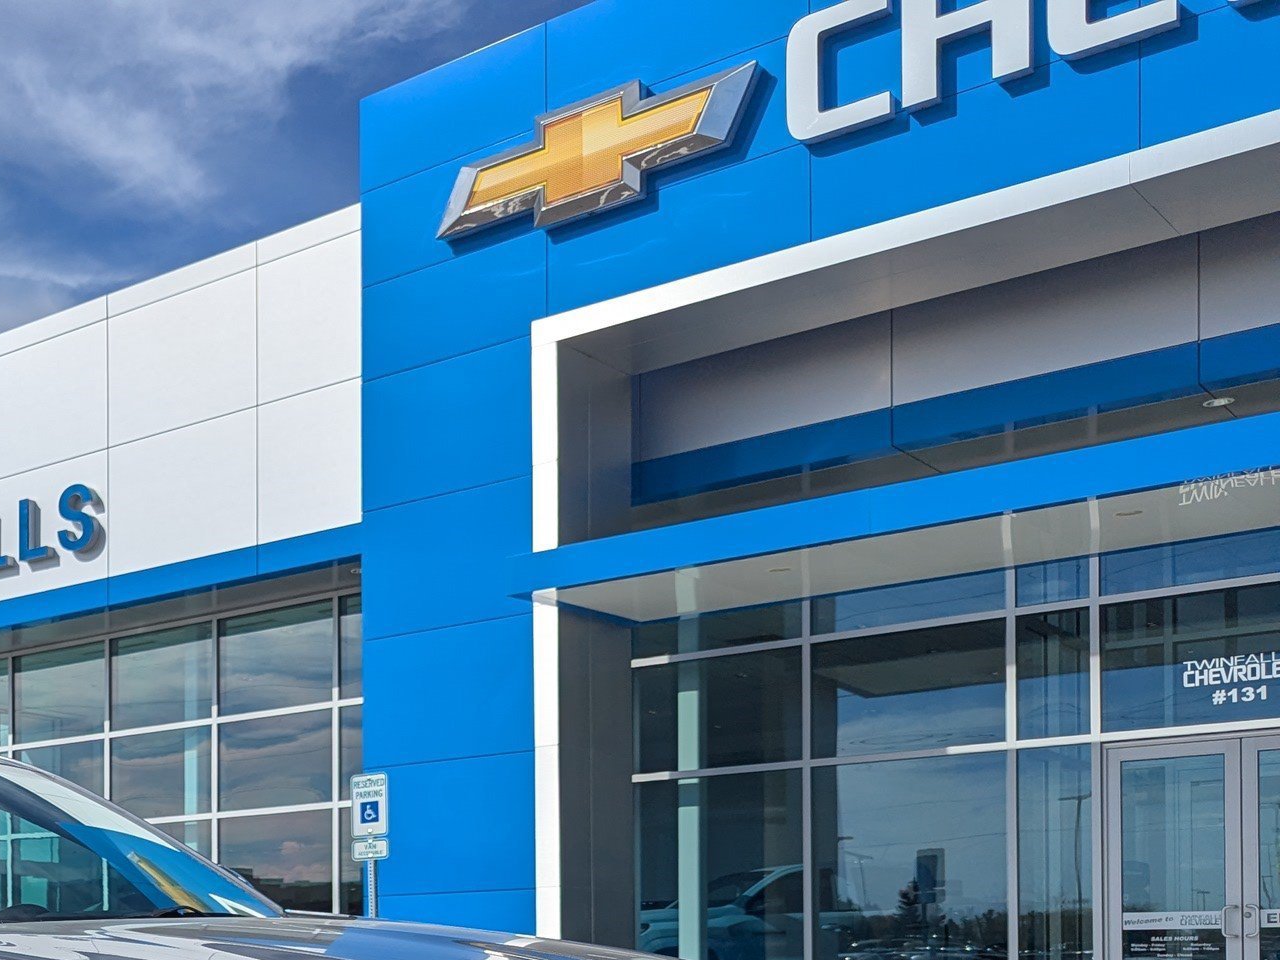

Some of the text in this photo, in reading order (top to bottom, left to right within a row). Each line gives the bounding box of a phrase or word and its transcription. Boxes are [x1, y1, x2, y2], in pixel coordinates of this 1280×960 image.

[786, 0, 1280, 143] CH
[1212, 685, 1267, 705] #131
[353, 778, 385, 789] RESERVED
[355, 789, 383, 799] PARKING
[363, 843, 377, 851] VAN
[1124, 917, 1162, 926] Welcome
[1267, 913, 1280, 923] E
